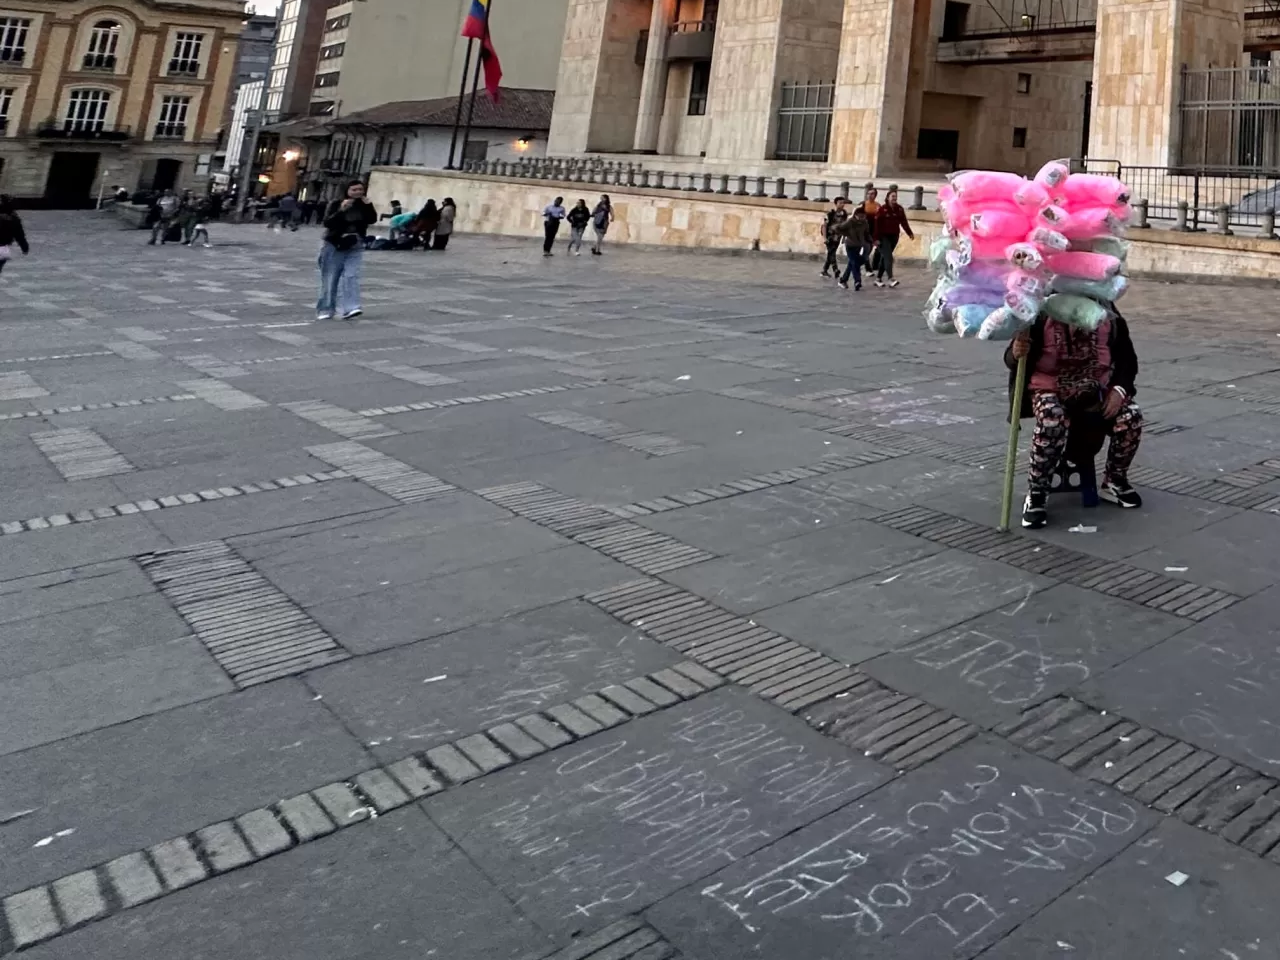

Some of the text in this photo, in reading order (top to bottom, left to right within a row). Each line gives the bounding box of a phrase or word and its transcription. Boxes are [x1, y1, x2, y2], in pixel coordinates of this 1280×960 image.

[820, 783, 1066, 936] VIOLADOR
[899, 798, 1137, 949] PARA EL
